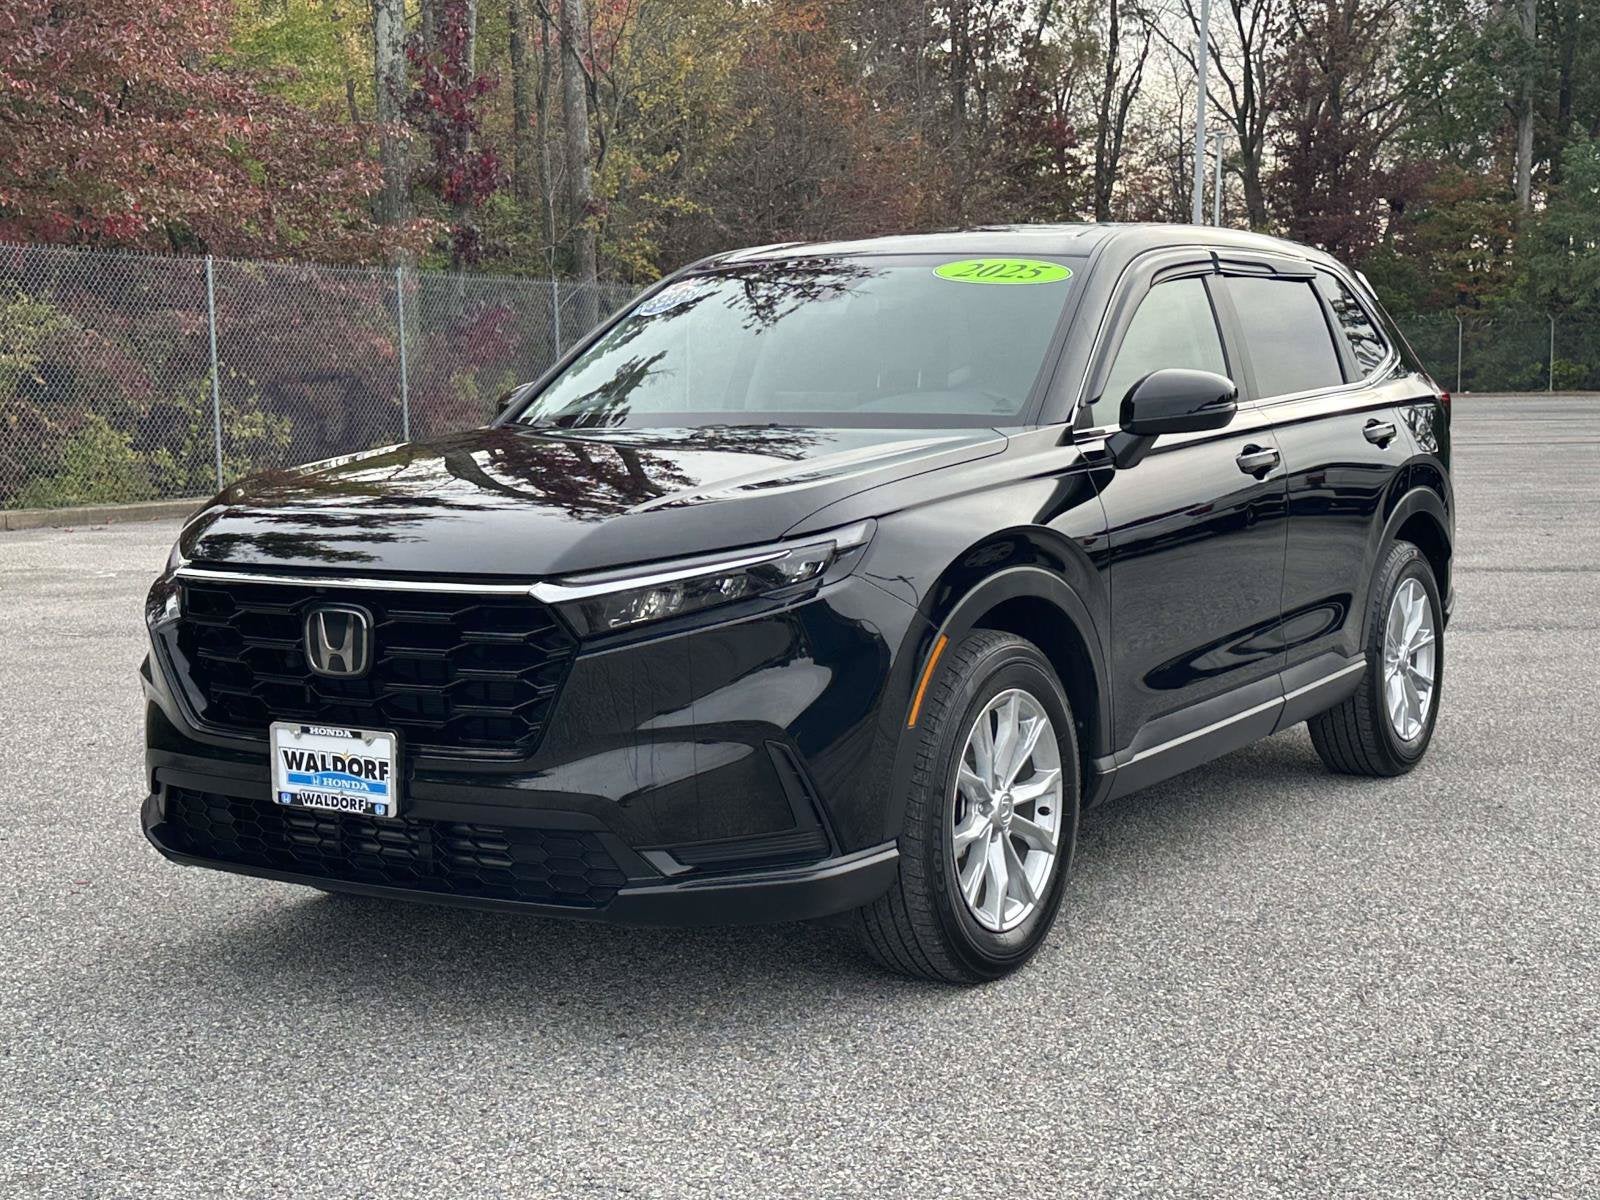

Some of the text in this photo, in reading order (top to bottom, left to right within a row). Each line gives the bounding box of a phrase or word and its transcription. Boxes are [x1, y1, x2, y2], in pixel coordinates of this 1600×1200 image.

[952, 263, 1051, 279] 2025
[309, 726, 352, 738] HONDA
[282, 750, 389, 781] WALDORF
[322, 777, 370, 792] HONDA
[302, 793, 365, 811] WALDORF
